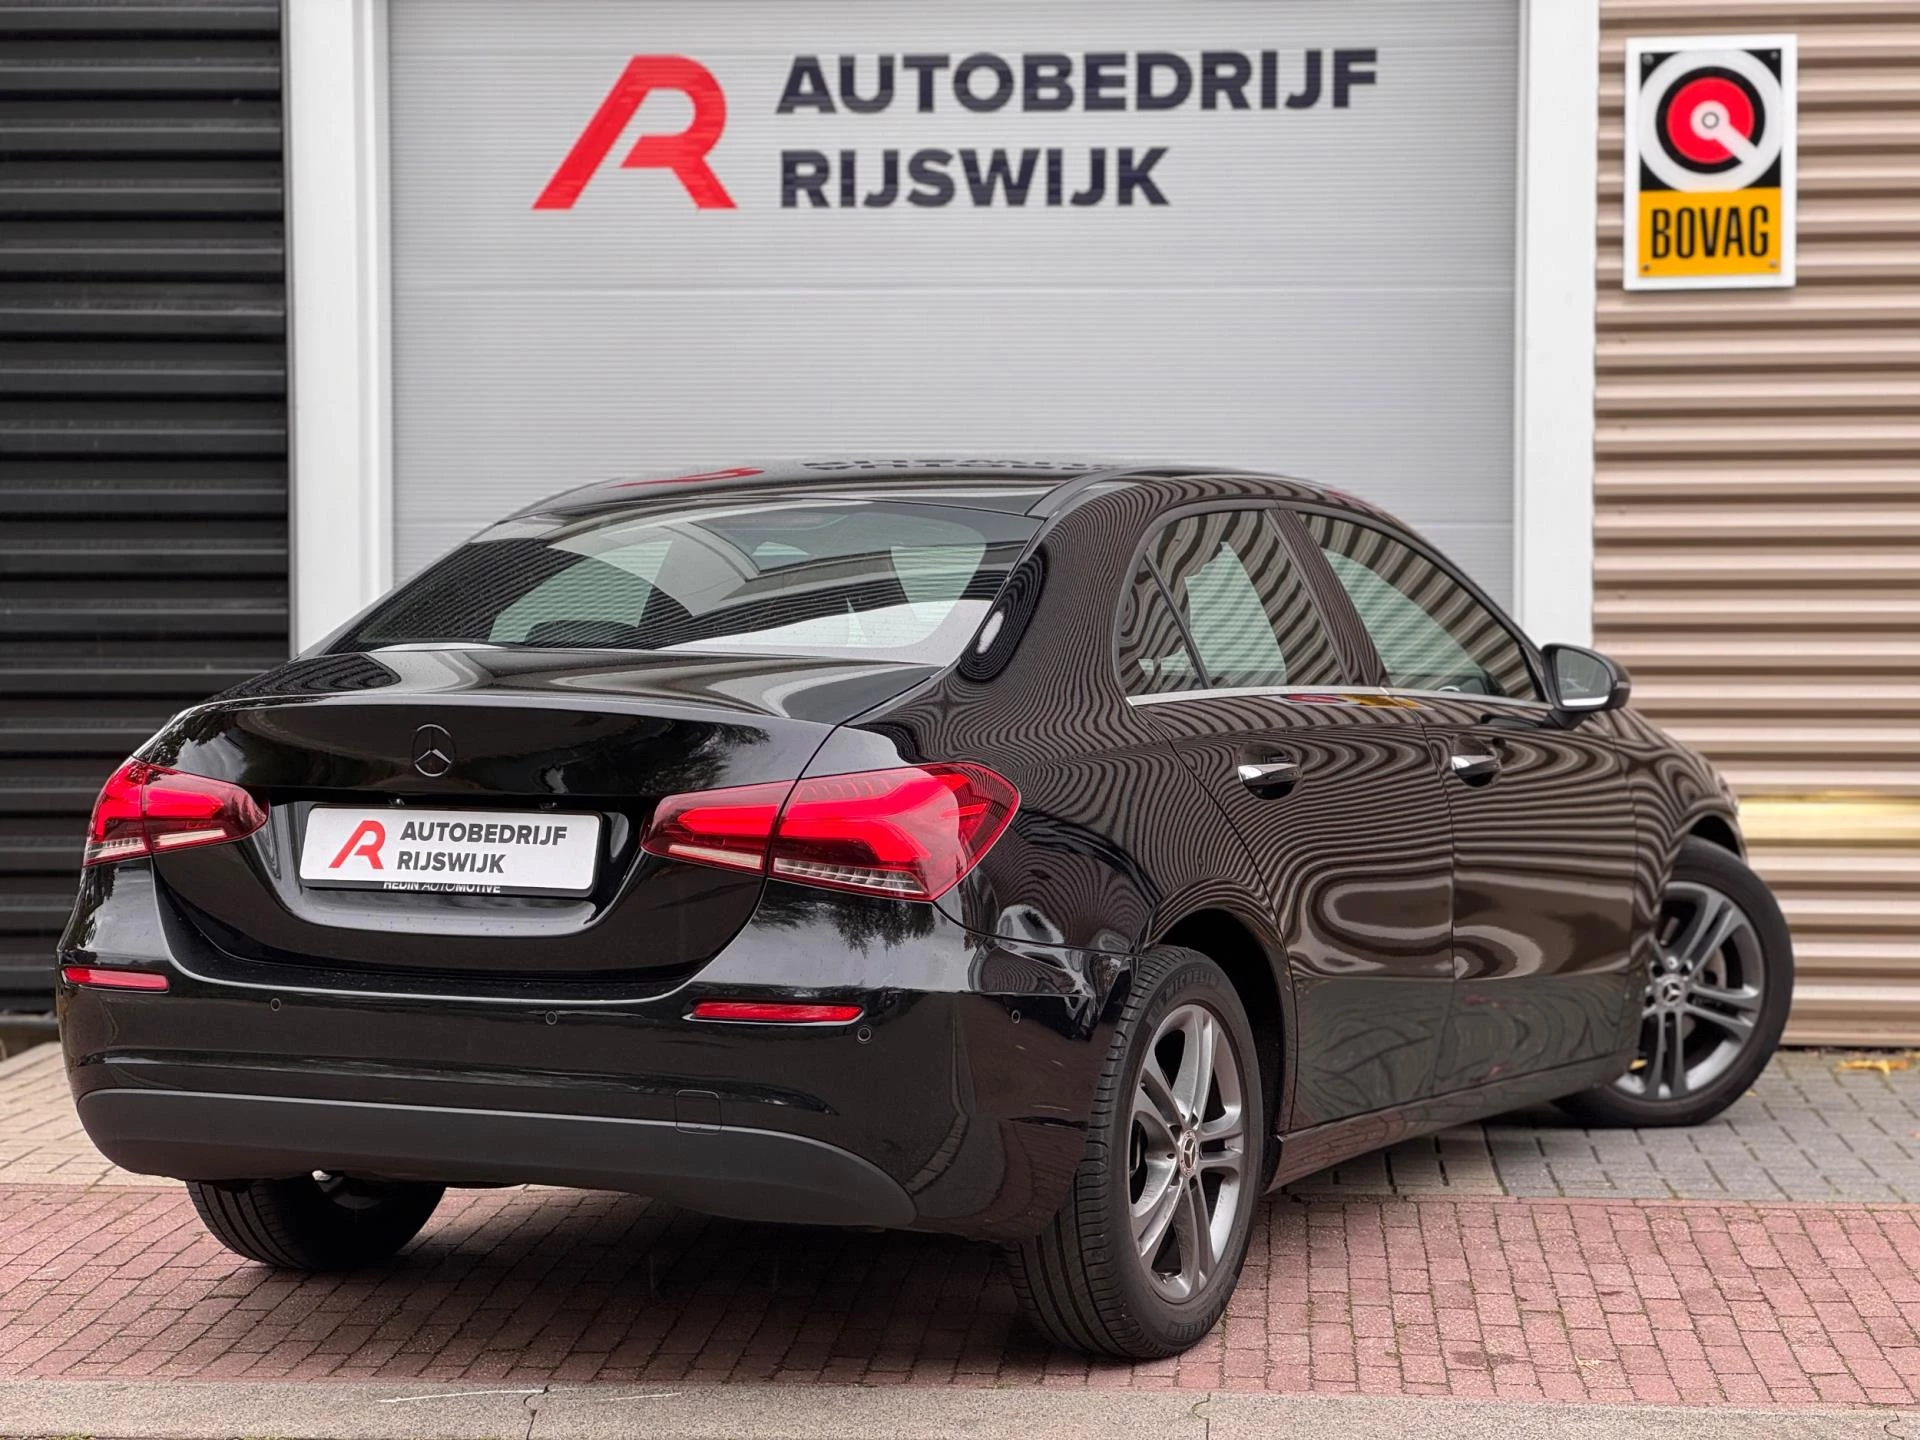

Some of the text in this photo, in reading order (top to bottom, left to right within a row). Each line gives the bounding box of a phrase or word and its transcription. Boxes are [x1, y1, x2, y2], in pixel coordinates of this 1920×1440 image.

[776, 49, 1377, 114] AUTOBEDRIJF
[780, 148, 1170, 208] RIJSWIJK
[1652, 205, 1769, 258] BOVAG
[400, 821, 567, 846] AUTOBEDRIJF
[397, 851, 505, 873] RIJSWIJK
